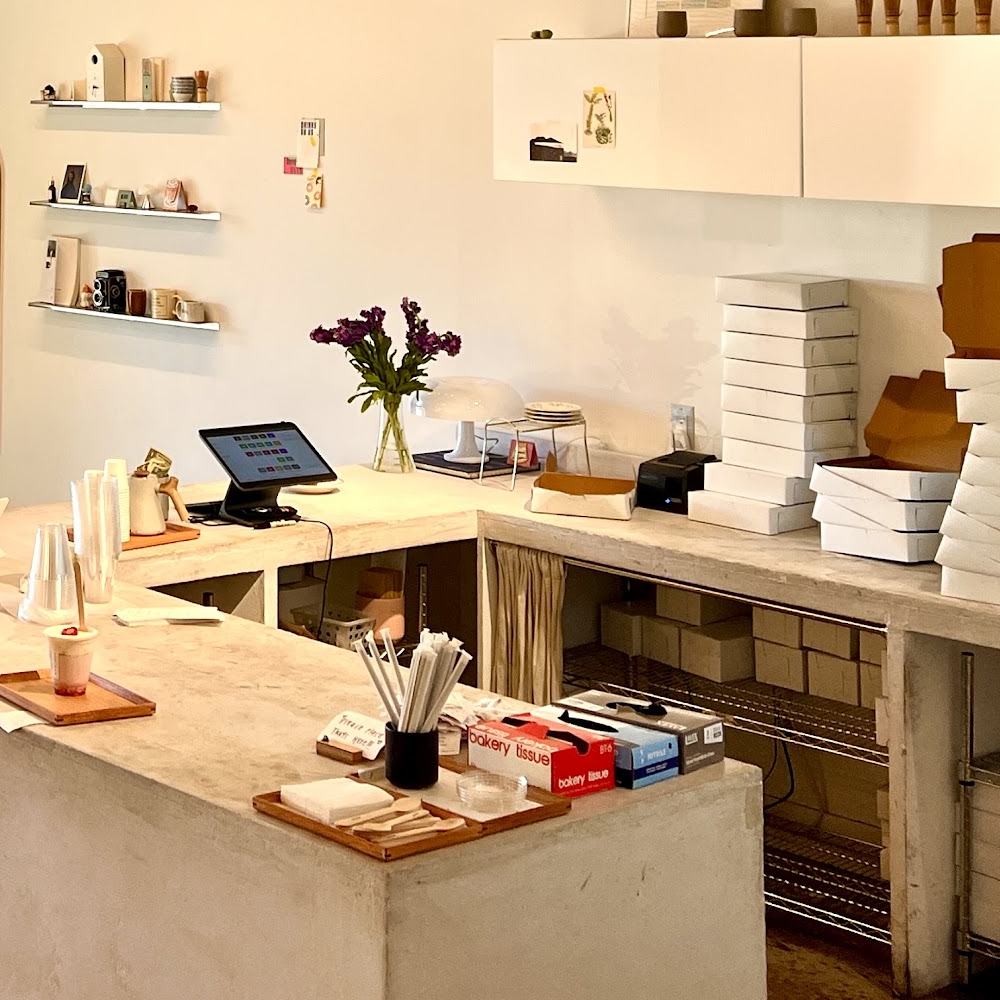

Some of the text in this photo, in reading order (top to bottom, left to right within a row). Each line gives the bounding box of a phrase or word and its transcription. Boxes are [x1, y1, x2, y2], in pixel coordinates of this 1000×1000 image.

[469, 729, 511, 757] bakery
[516, 743, 550, 767] tissue
[558, 769, 609, 789] bakery tissue
